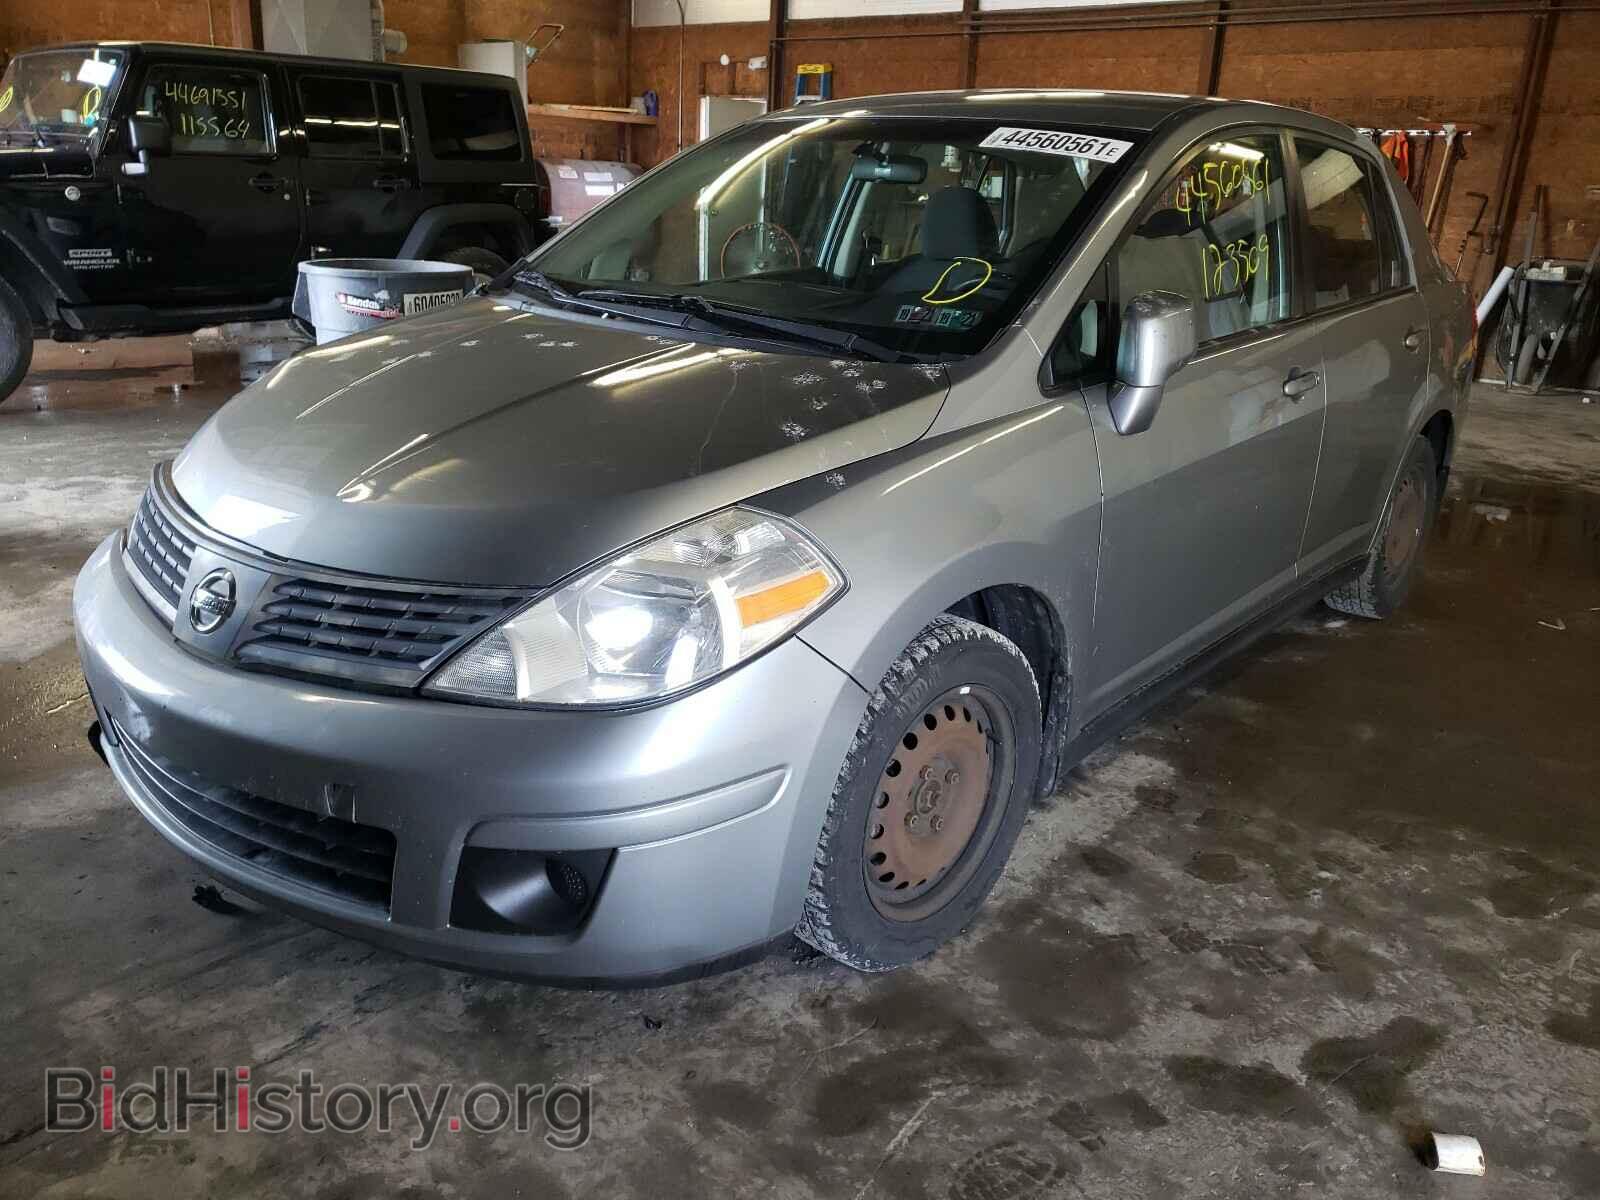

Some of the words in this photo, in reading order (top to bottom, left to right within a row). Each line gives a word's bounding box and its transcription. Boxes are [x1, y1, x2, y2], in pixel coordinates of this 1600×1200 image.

[1001, 130, 1112, 155] 44560561
[1106, 147, 1119, 157] E
[1202, 234, 1270, 300] 123509
